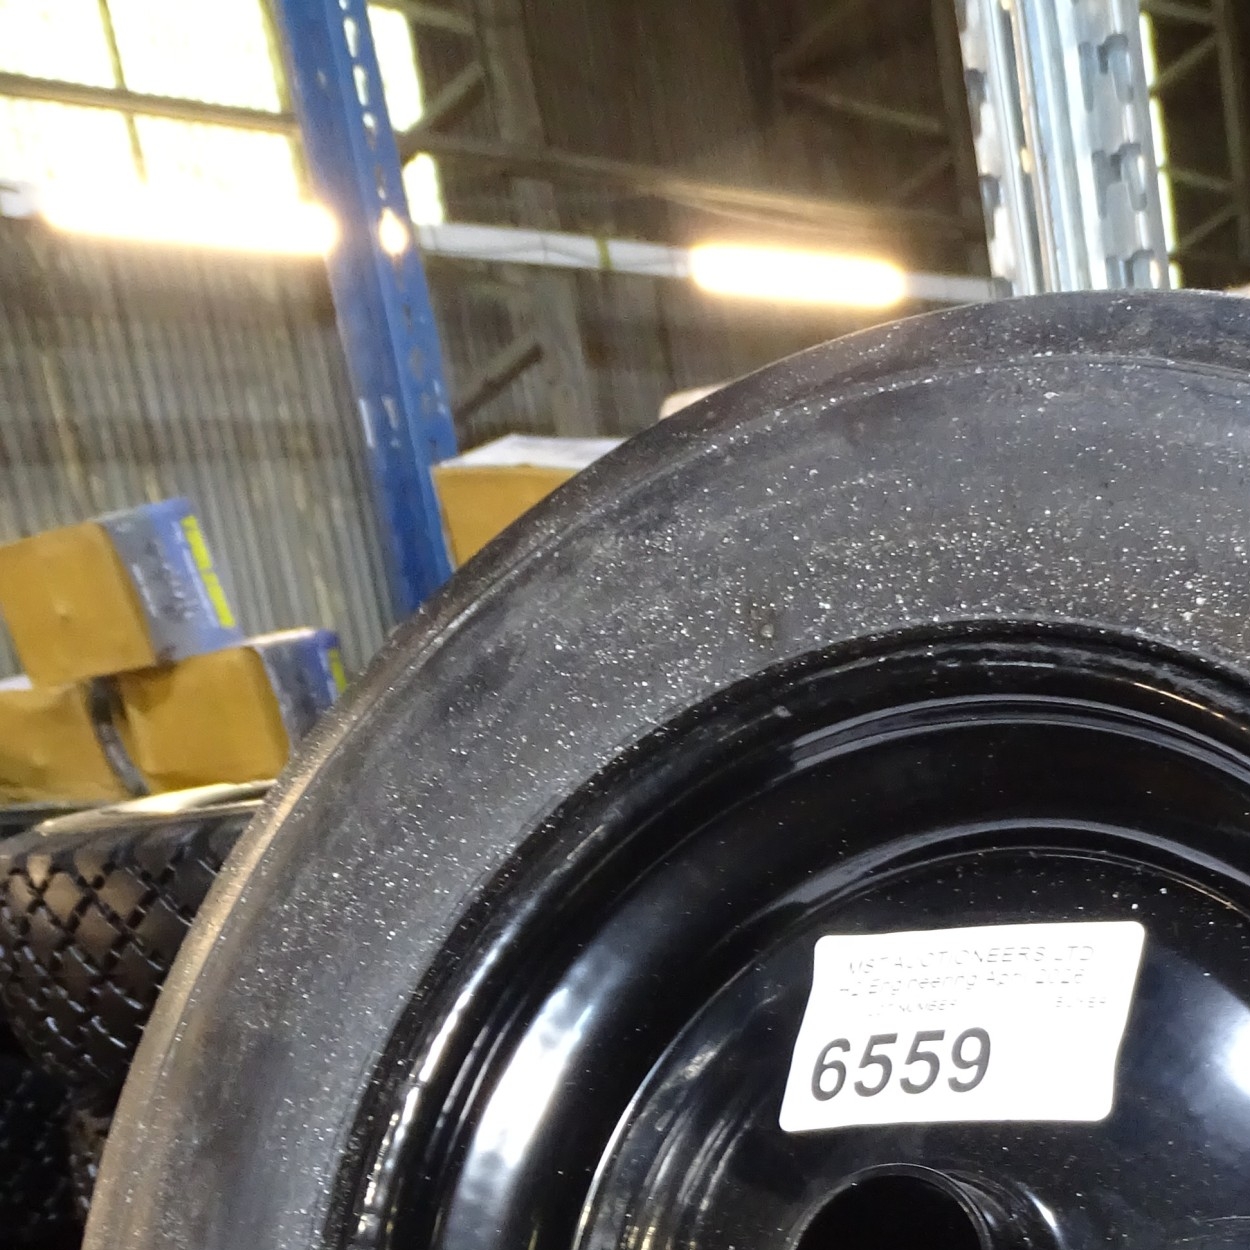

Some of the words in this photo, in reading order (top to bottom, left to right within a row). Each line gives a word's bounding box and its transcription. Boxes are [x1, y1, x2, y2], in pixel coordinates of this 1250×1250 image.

[892, 946, 1047, 969] ACTIONEERS
[868, 973, 978, 996] Engneerng
[986, 969, 1028, 986] Apr
[811, 1027, 991, 1101] 6559
